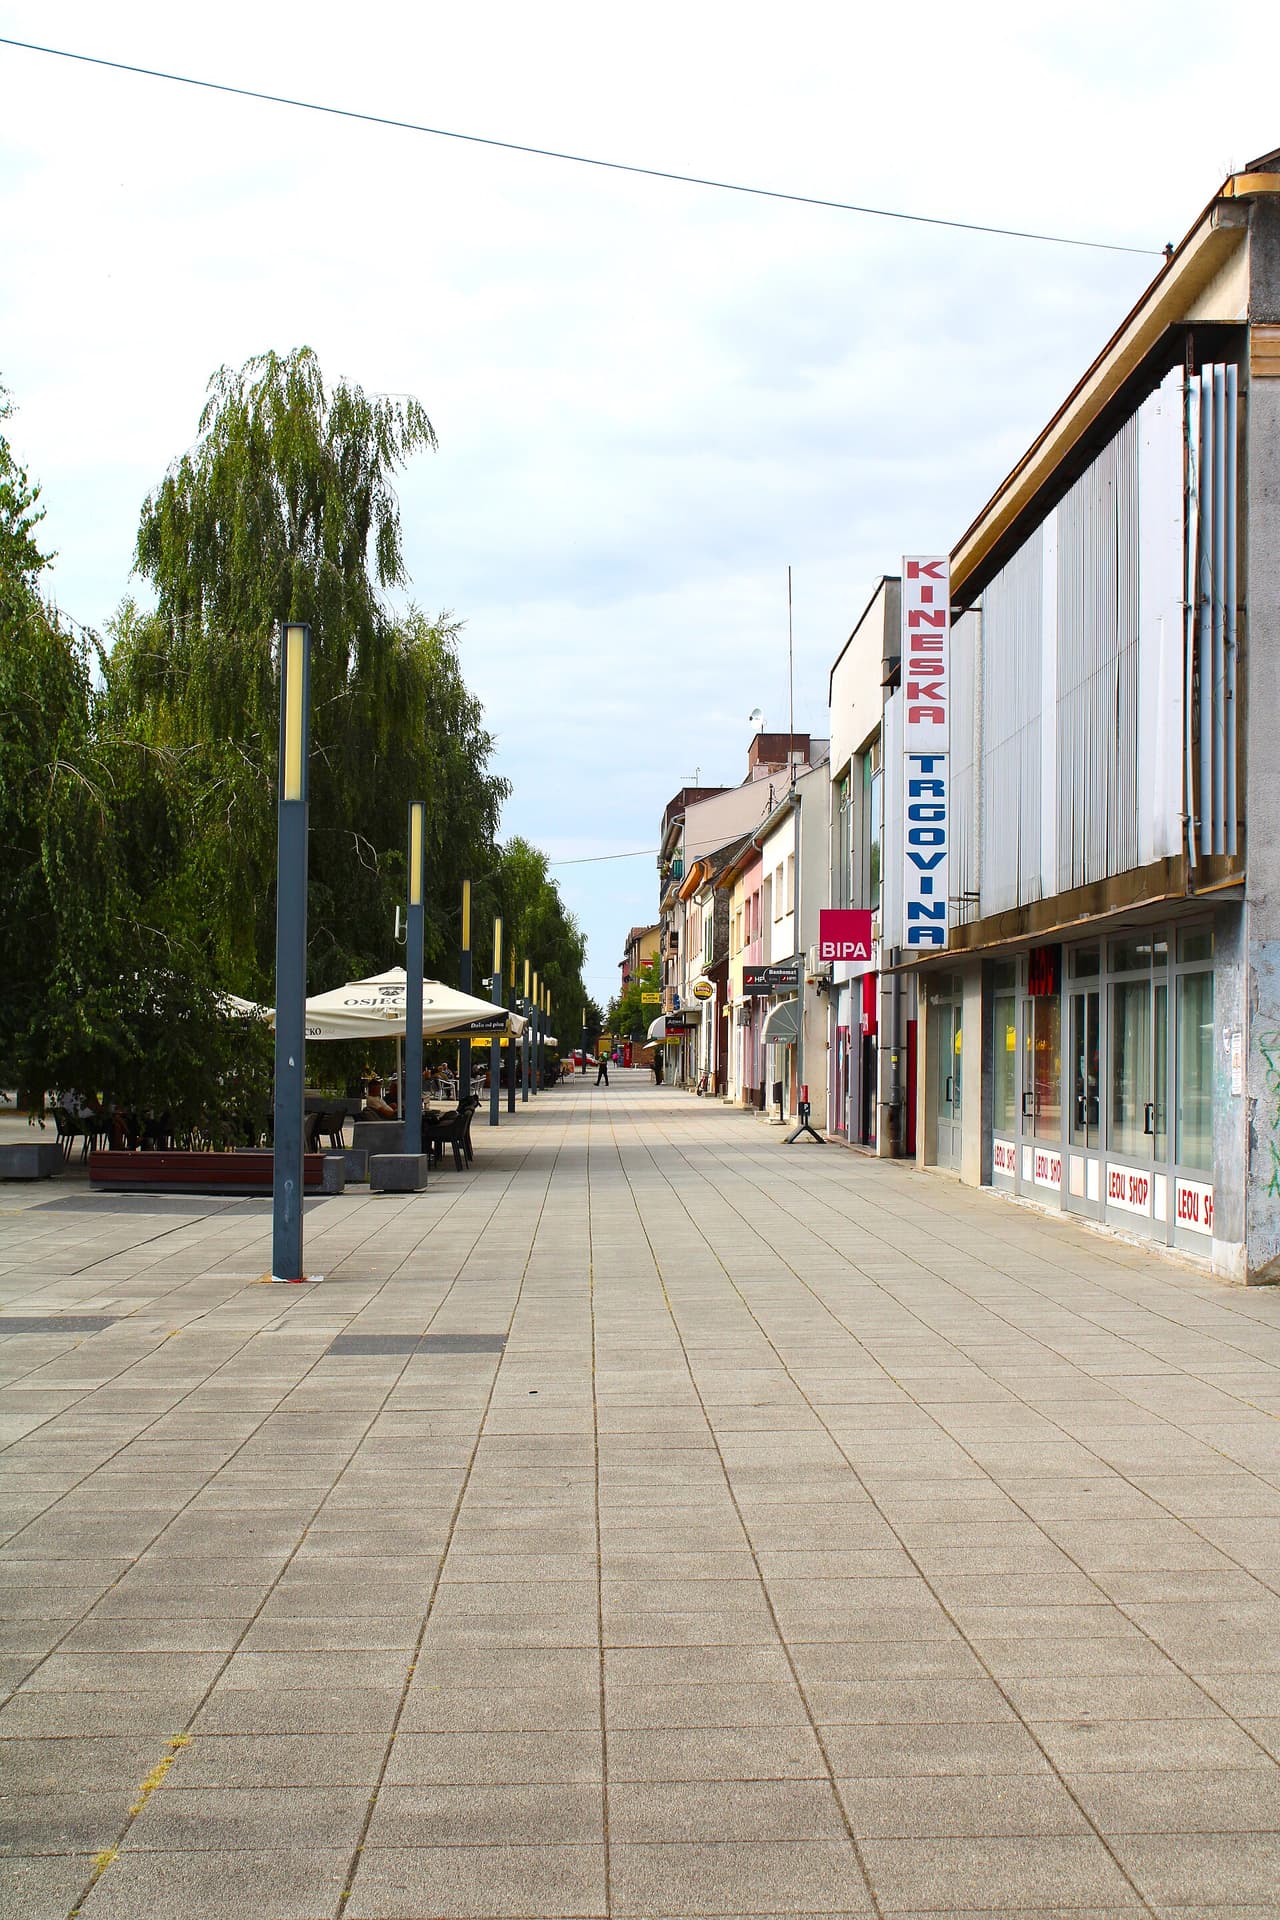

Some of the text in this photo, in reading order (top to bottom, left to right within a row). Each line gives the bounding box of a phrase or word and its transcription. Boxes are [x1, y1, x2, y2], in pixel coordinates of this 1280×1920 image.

[907, 561, 947, 724] KINESKA
[906, 755, 947, 944] TRGOVINA
[822, 942, 867, 958] BIPA
[1036, 1155, 1049, 1179] LEOU
[1108, 1171, 1149, 1206] LEOU SHOP
[1178, 1188, 1199, 1222] LEOU
